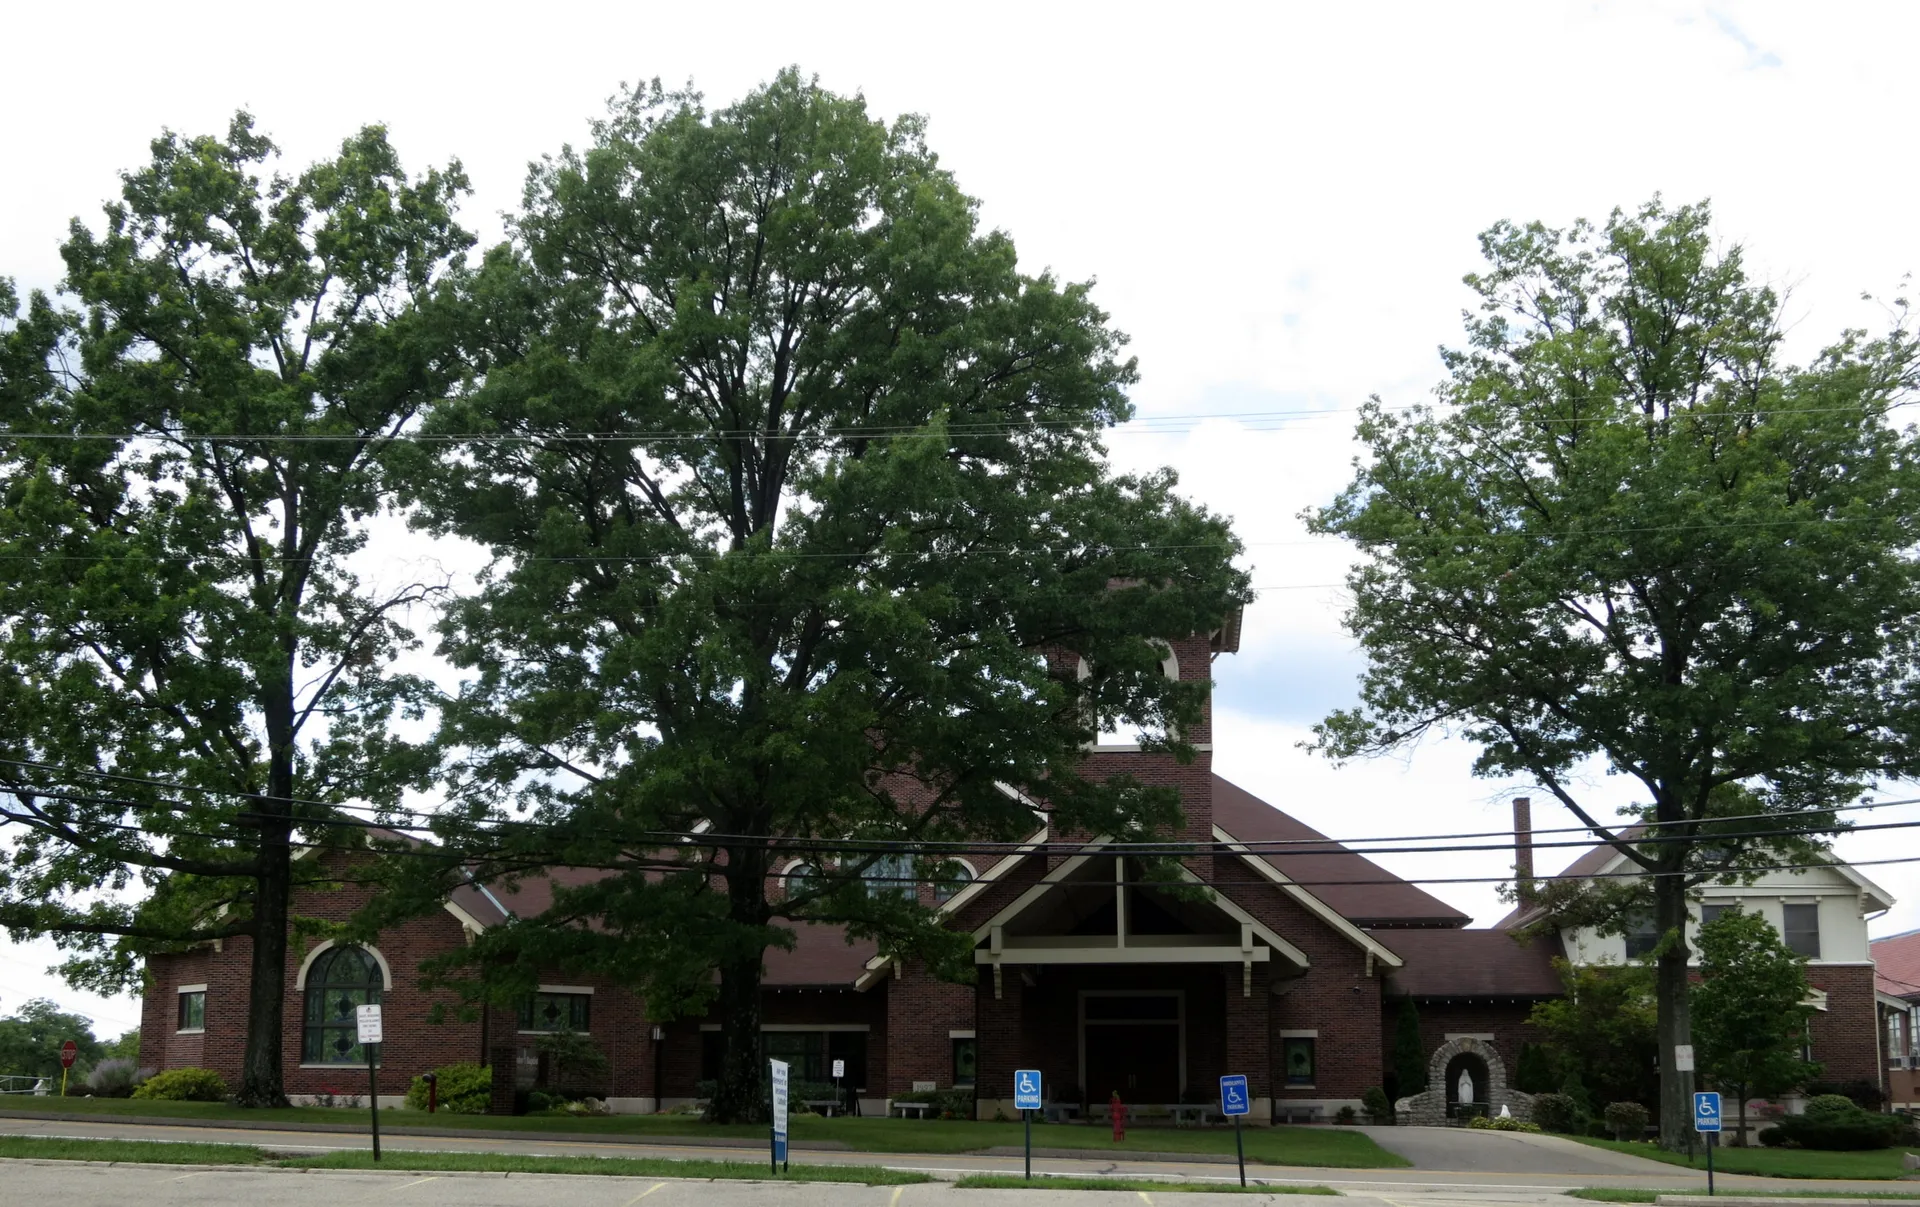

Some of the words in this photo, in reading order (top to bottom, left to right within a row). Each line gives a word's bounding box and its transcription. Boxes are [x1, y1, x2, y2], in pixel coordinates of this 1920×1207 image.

[62, 1049, 76, 1060] STOP
[1018, 1095, 1038, 1103] PARKING
[1698, 1117, 1718, 1126] PARKING
